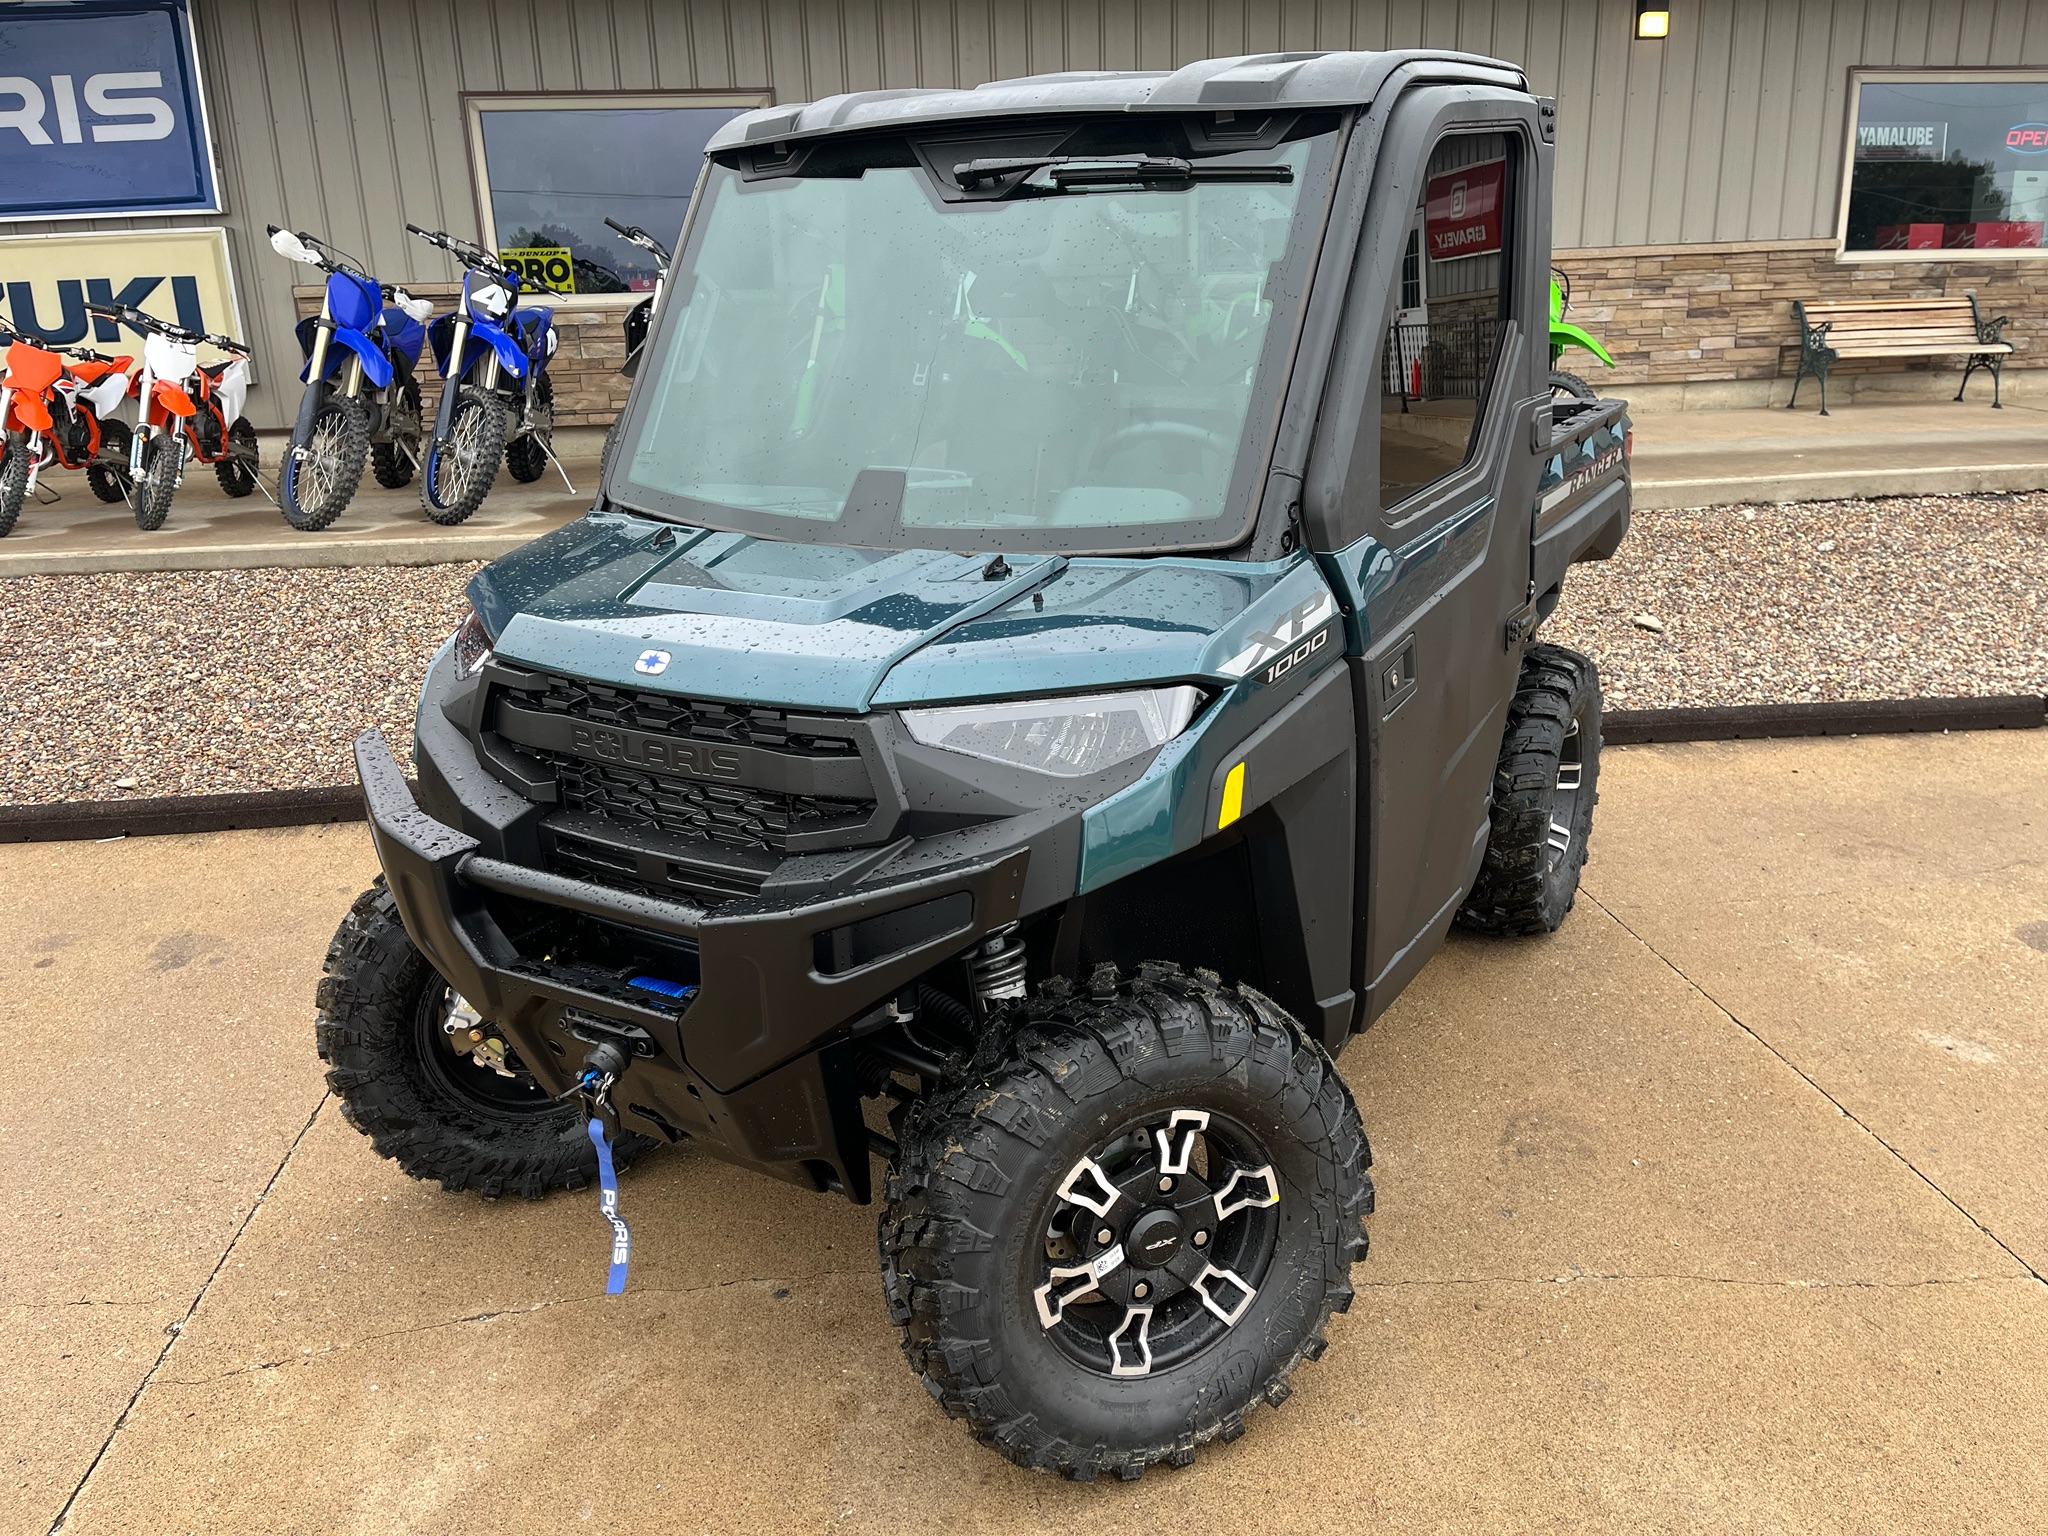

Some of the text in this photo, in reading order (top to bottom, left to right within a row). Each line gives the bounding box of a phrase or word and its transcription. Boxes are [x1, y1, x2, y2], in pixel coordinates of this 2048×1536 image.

[1859, 126, 1934, 146] YAMALUBE
[0, 276, 206, 347] UKI
[1243, 590, 1326, 674] XP
[1267, 628, 1328, 684] 1000
[569, 722, 742, 781] POLARIS
[601, 1188, 628, 1265] POLARIS
